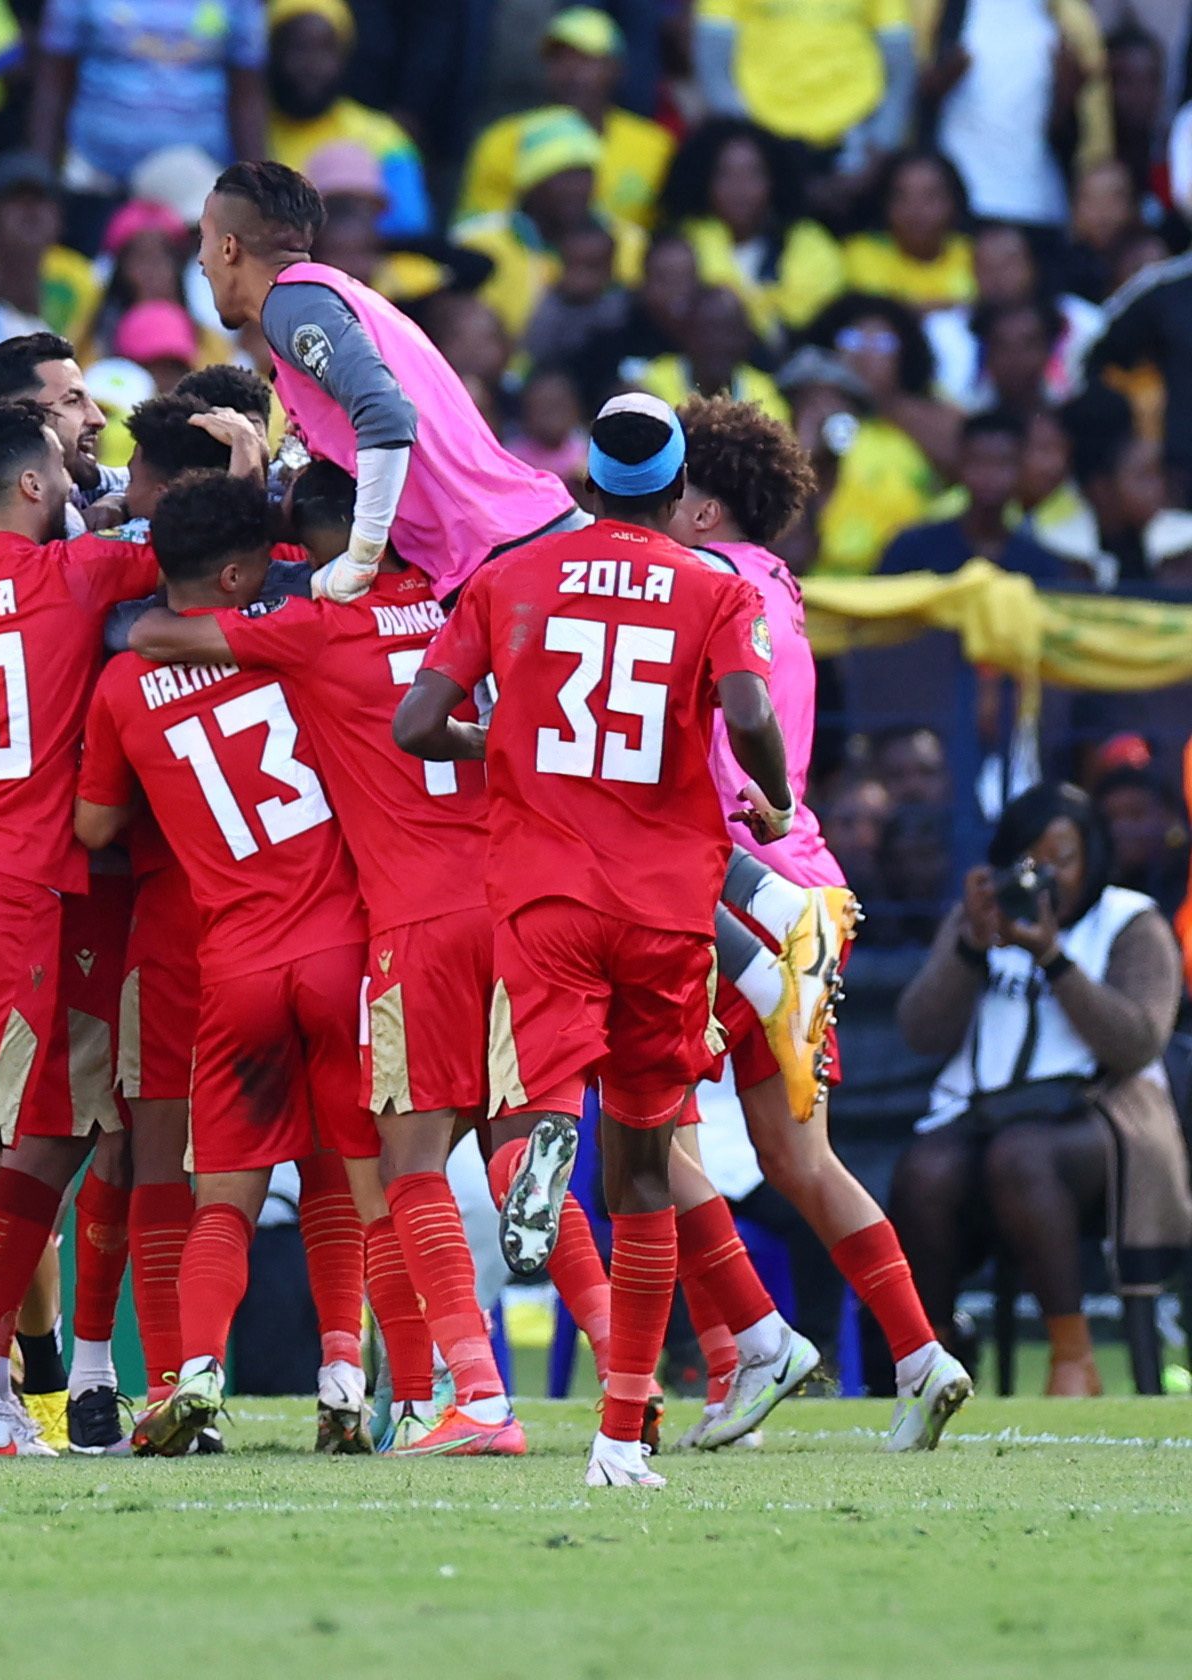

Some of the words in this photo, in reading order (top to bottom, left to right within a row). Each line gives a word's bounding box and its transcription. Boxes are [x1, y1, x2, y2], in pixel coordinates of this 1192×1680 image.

[558, 560, 675, 604] ZOLA
[163, 682, 333, 861] 13
[536, 616, 676, 784] 35
